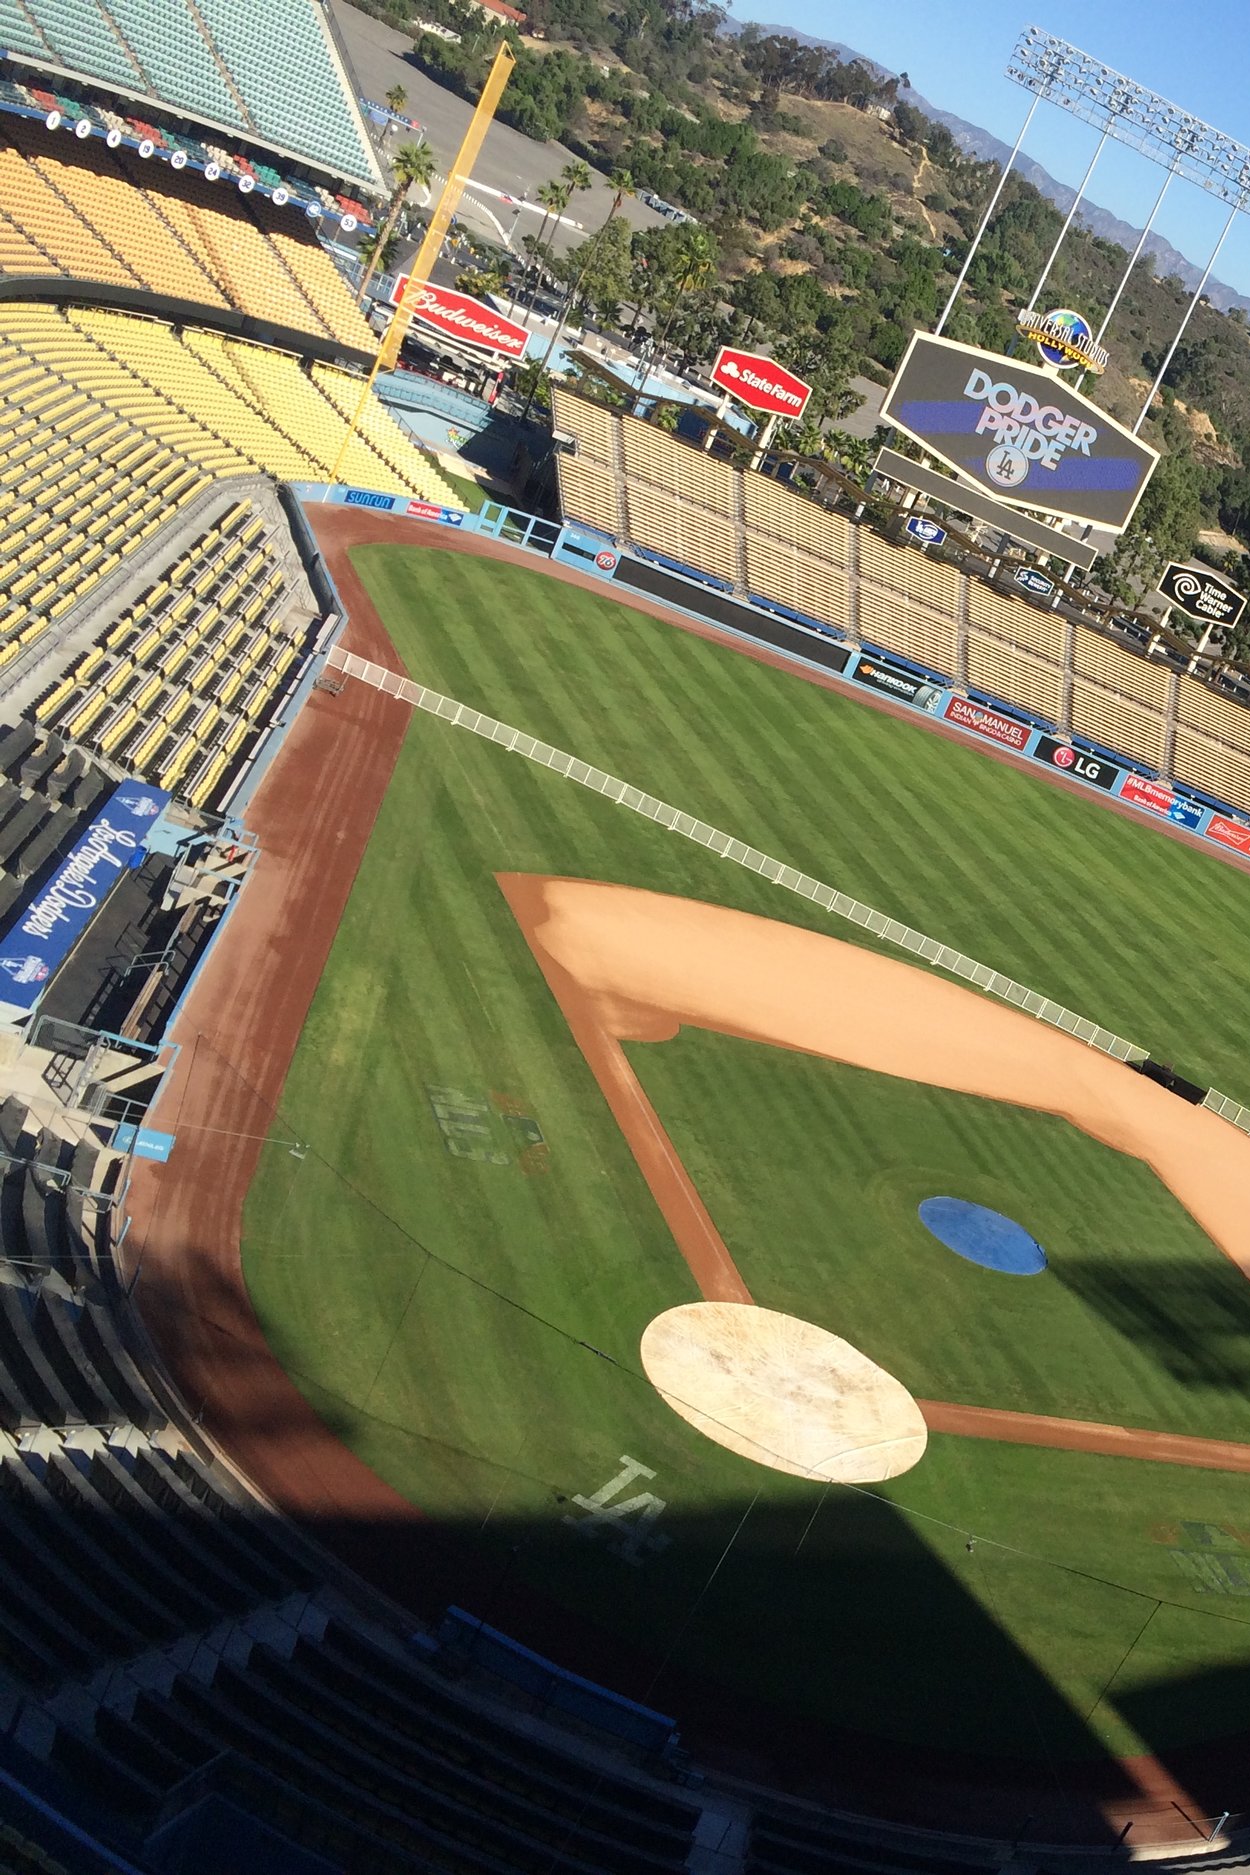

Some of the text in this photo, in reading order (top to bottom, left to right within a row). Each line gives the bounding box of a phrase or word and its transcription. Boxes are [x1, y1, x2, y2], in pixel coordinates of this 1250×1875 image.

[174, 155, 184, 165] 20
[207, 167, 218, 177] 24
[242, 179, 251, 189] 32
[344, 218, 354, 228] 53
[403, 284, 523, 348] Budweiser
[1018, 309, 1109, 368] UNIVERSAL STUDIOS
[1028, 331, 1093, 368] HOLLYWOOD
[963, 368, 1097, 456] DODGER
[975, 406, 1066, 471] PRIDE
[996, 450, 1015, 480] LA
[407, 504, 421, 514] Bank
[599, 554, 614, 566] 76
[1200, 590, 1233, 613] Warner
[1205, 582, 1227, 601] Time
[1195, 600, 1223, 619] Cable
[950, 711, 972, 725] INDIAN
[979, 724, 997, 736] BINGO
[1001, 732, 1022, 746] CASINO
[952, 702, 1023, 741] SAN MANUEL
[1074, 757, 1101, 779] LG
[1126, 777, 1203, 818] #MLBmemorybank
[22, 818, 136, 940] Los Angeles Dodgers
